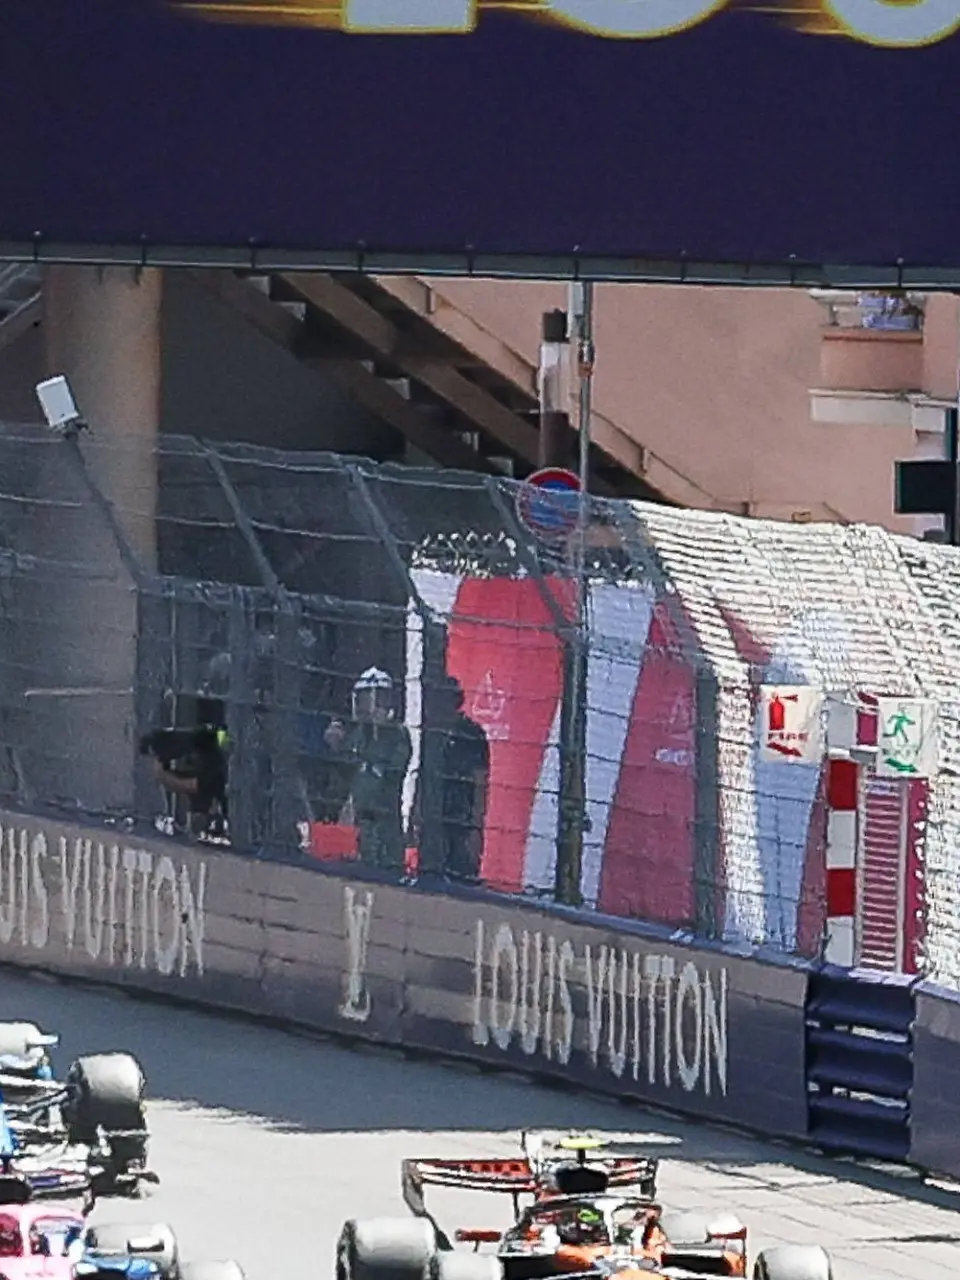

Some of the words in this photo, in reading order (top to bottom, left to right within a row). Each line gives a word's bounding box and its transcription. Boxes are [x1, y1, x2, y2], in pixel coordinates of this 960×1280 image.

[54, 834, 207, 978] VUITTON
[471, 919, 574, 1066] LOUIS
[584, 943, 729, 1097] VUITTON
